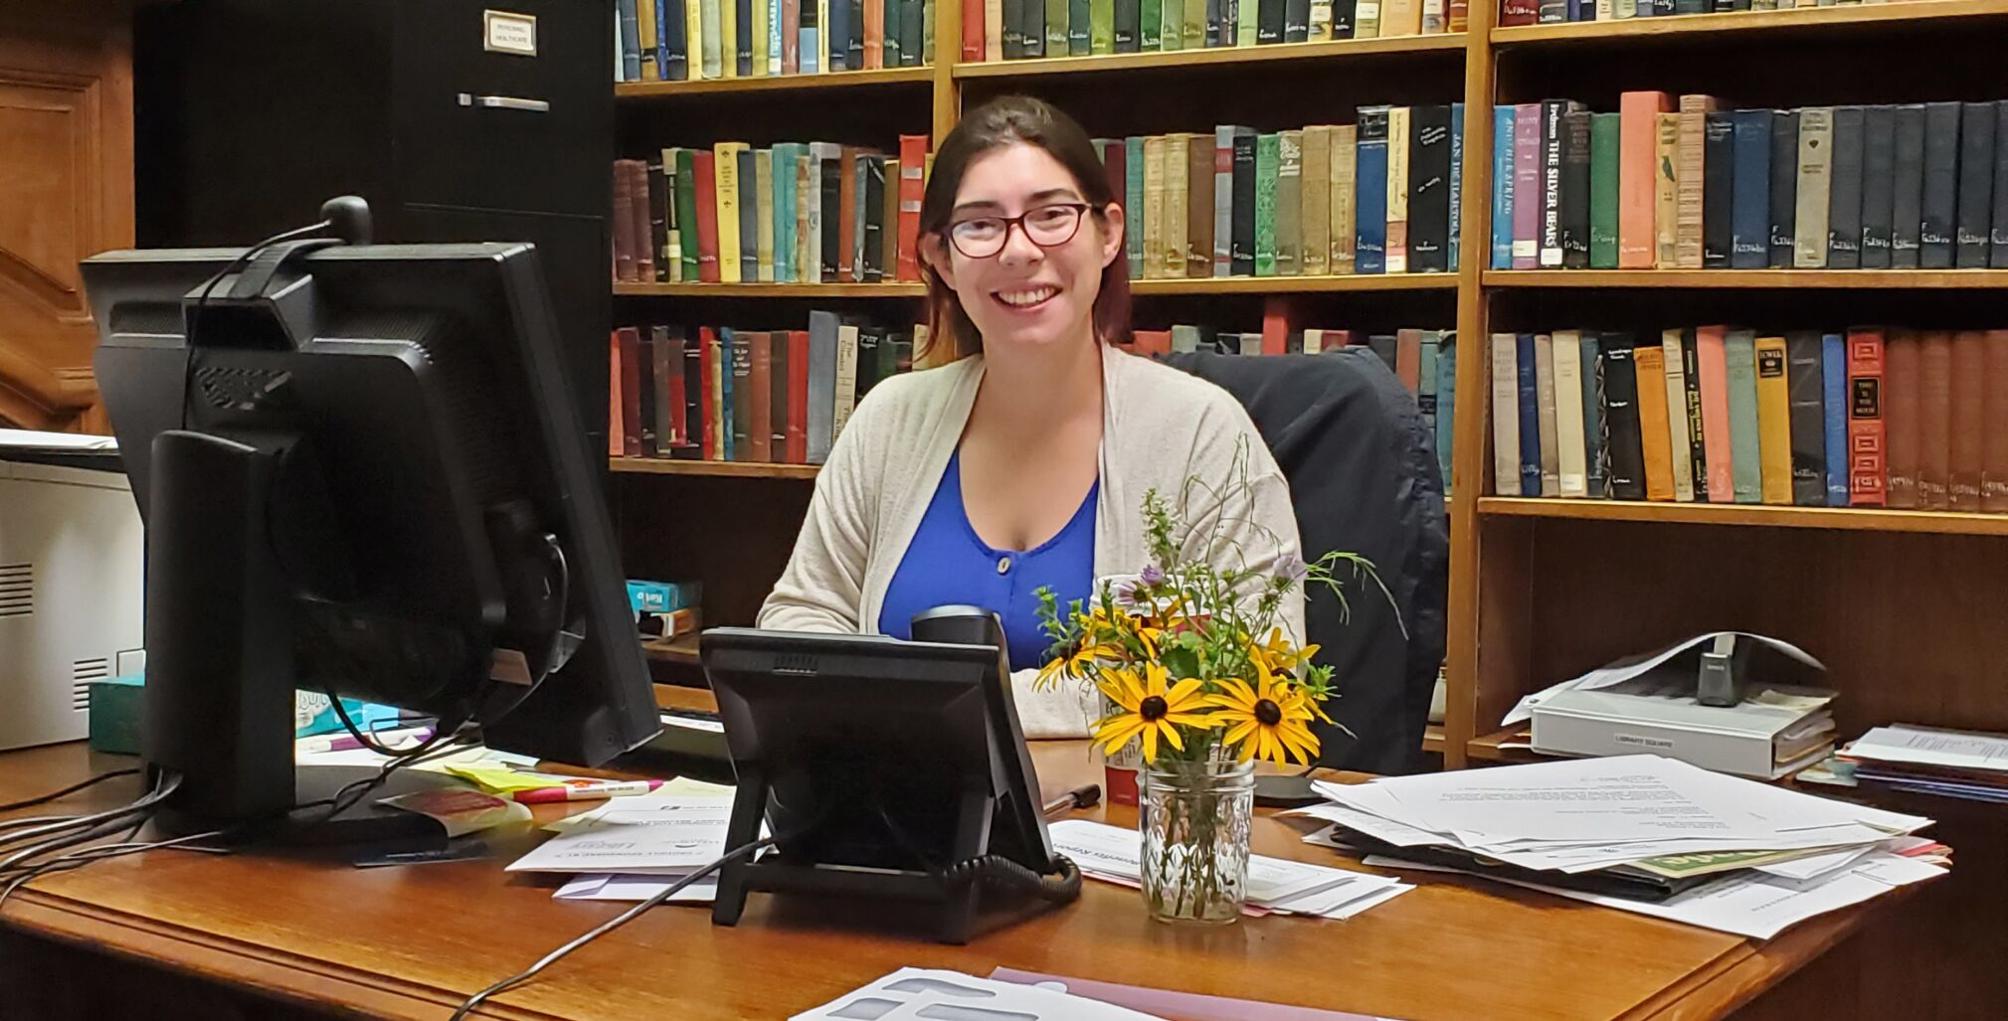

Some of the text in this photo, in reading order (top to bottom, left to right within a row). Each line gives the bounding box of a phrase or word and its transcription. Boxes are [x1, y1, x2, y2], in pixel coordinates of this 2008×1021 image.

[1453, 133, 1461, 157] JAN
[1548, 141, 1560, 166] THE
[1504, 172, 1514, 215] SPRING
[1546, 168, 1559, 208] SILVER
[1545, 210, 1558, 247] BEARS
